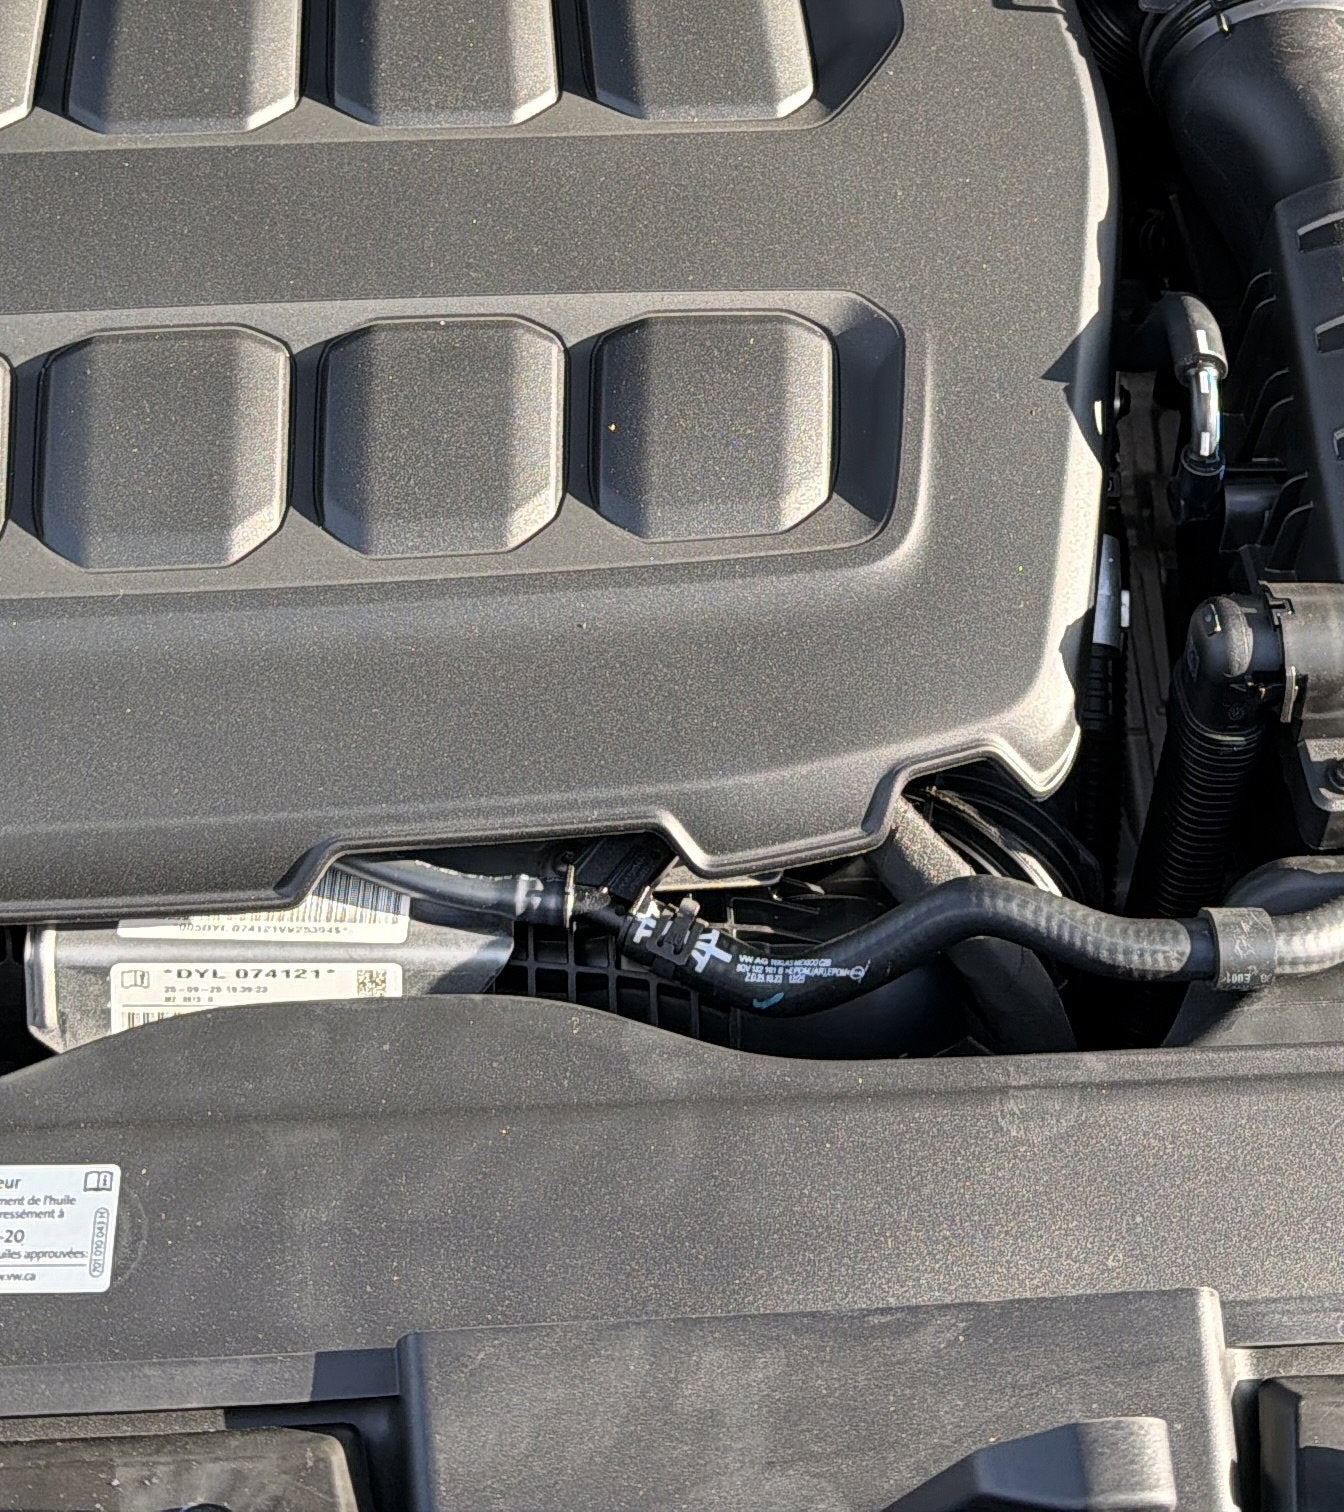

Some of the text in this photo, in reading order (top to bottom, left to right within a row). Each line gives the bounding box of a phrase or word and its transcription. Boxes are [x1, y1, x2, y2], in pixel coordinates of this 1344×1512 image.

[27, 1195, 41, 1206] de
[43, 1194, 77, 1206] l'huile
[58, 1208, 65, 1219] à
[23, 1247, 88, 1262] approuvées:
